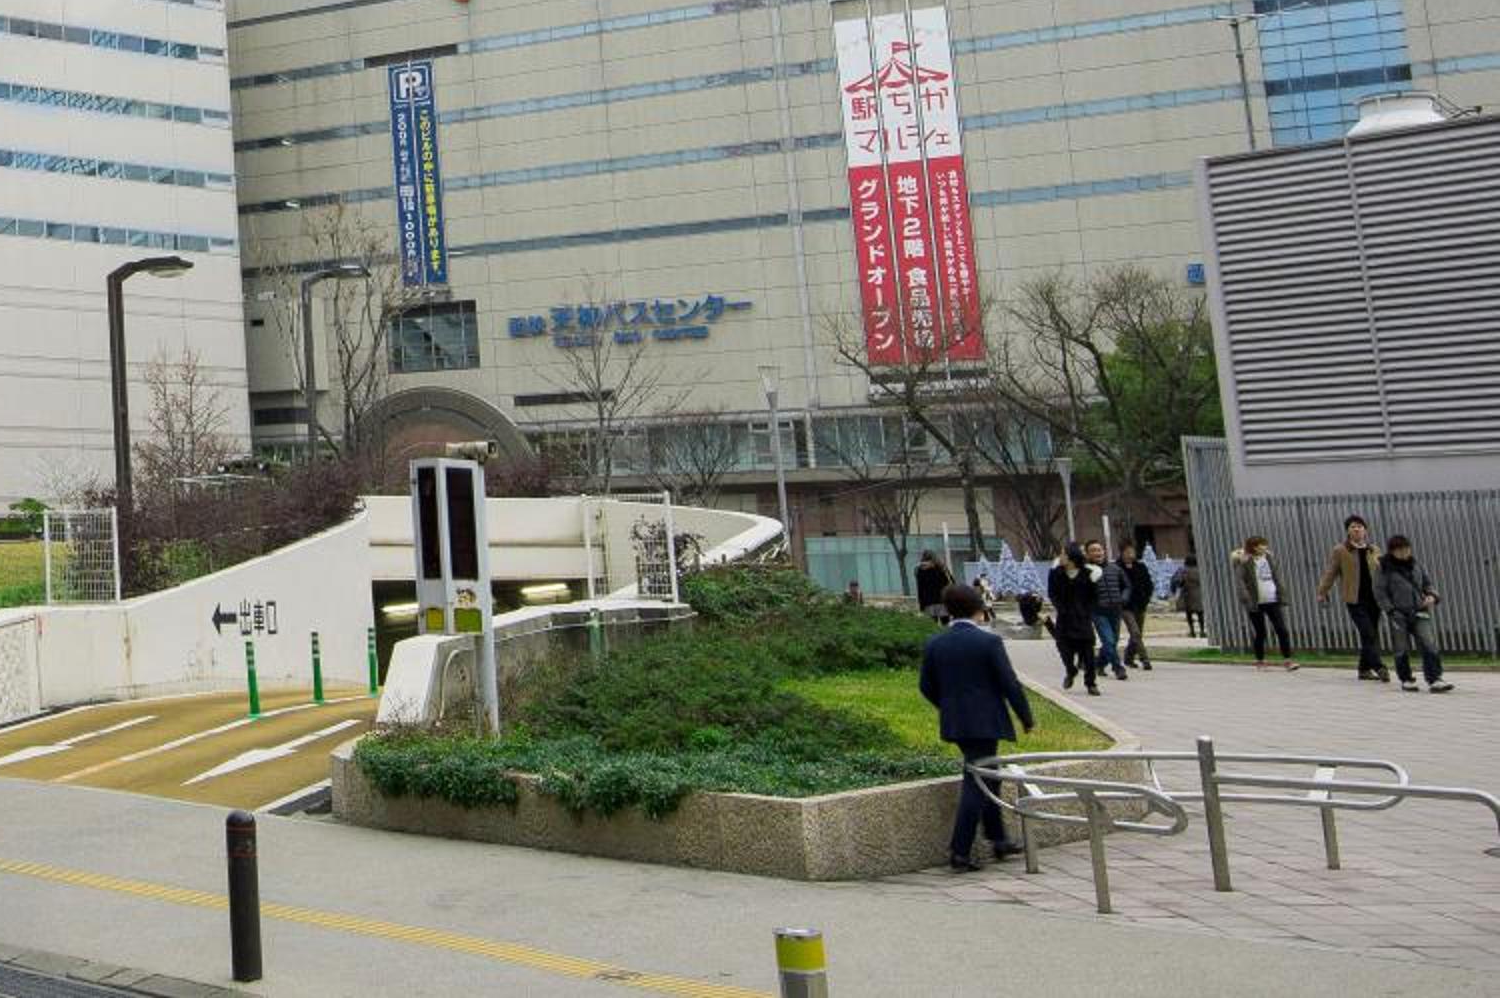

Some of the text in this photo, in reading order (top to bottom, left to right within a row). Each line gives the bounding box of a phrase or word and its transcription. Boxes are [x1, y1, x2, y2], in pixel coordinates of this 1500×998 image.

[851, 87, 950, 121] 駅ちか
[853, 125, 952, 153] マルシェ
[896, 174, 926, 259] 地下2階
[857, 178, 895, 350] グランドオープン
